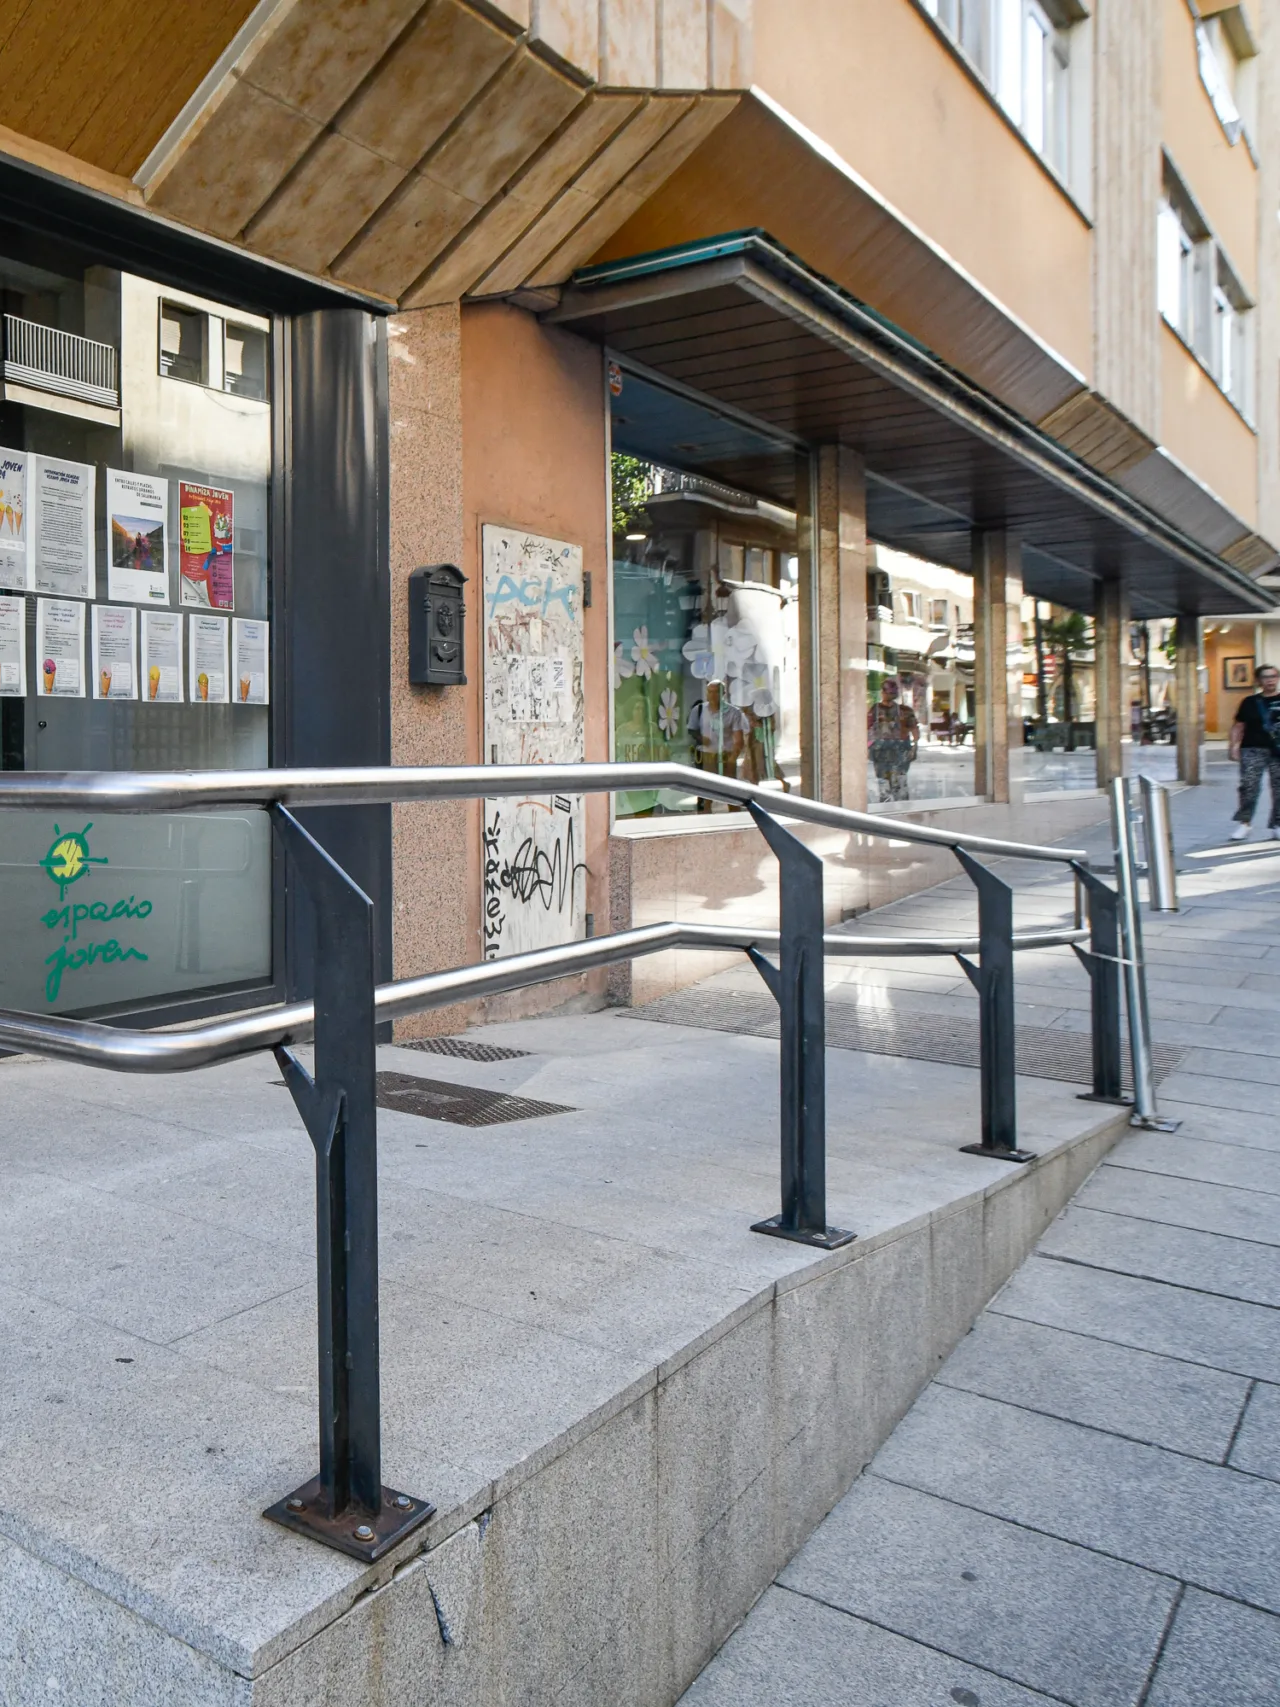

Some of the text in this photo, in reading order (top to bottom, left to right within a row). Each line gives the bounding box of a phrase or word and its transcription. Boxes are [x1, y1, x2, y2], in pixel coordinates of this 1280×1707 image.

[1, 460, 23, 473] JOVEN
[40, 895, 153, 941] espacio
[44, 935, 148, 1002] joven
